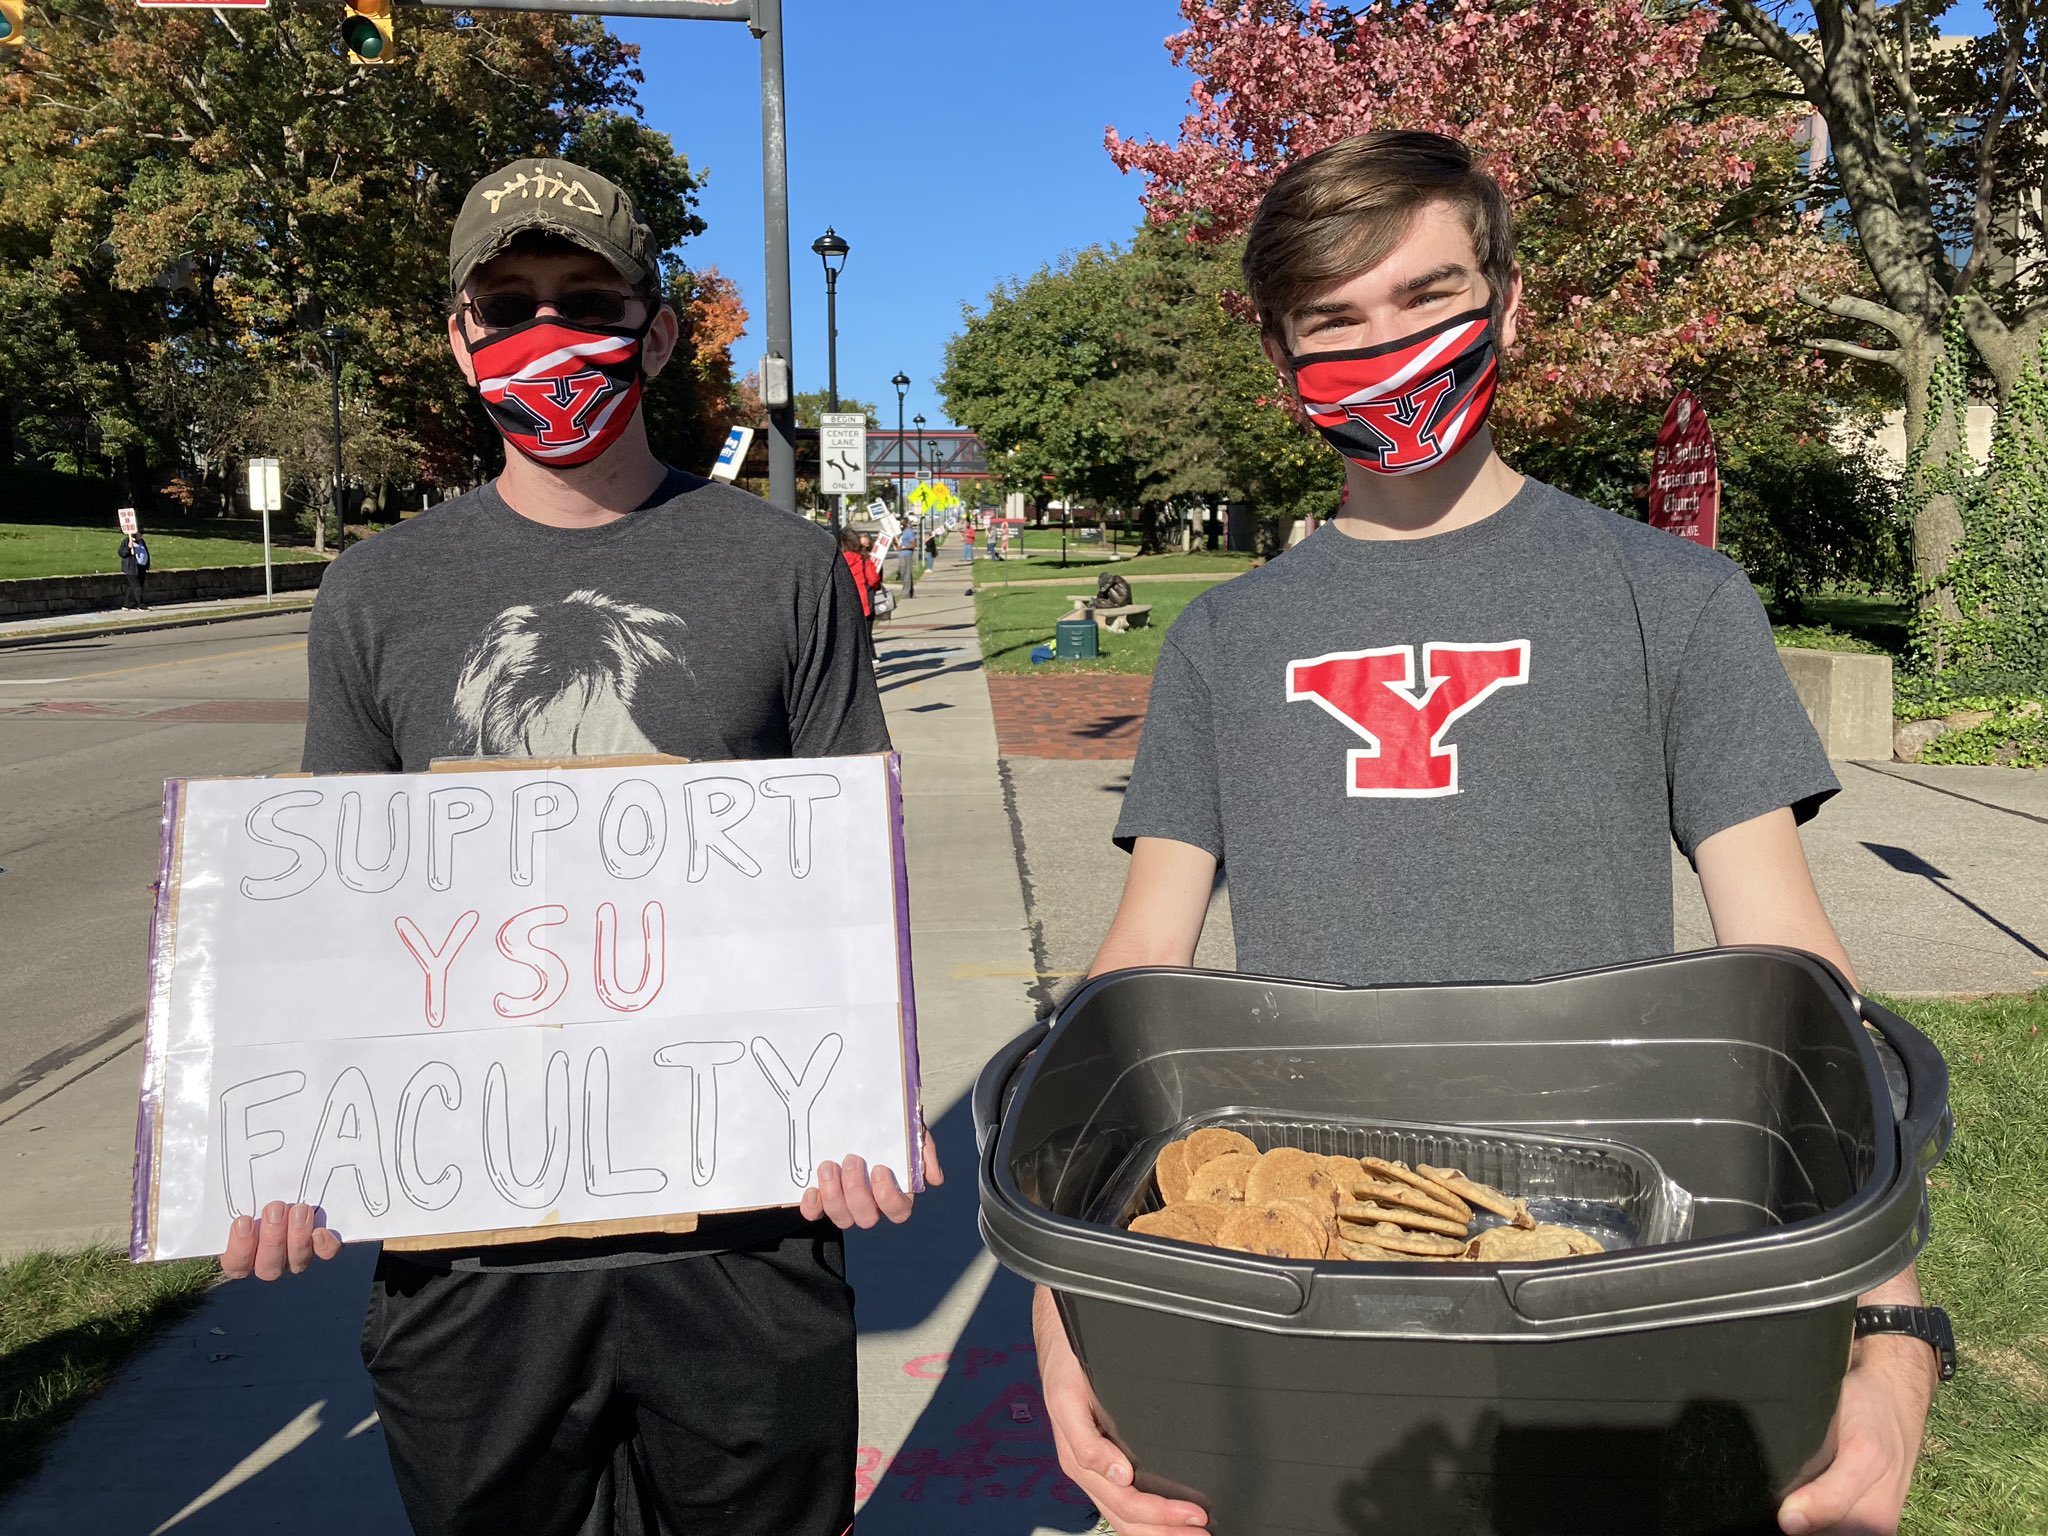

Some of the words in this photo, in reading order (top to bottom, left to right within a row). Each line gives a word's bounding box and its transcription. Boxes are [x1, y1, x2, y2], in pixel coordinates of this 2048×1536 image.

[502, 370, 613, 448] Y
[1339, 368, 1456, 470] Y
[1663, 491, 1700, 513] Church
[1286, 638, 1531, 798] Y
[239, 773, 841, 901] SUPPORT
[394, 900, 667, 1028] YSU
[219, 1032, 844, 1219] FACULTY
